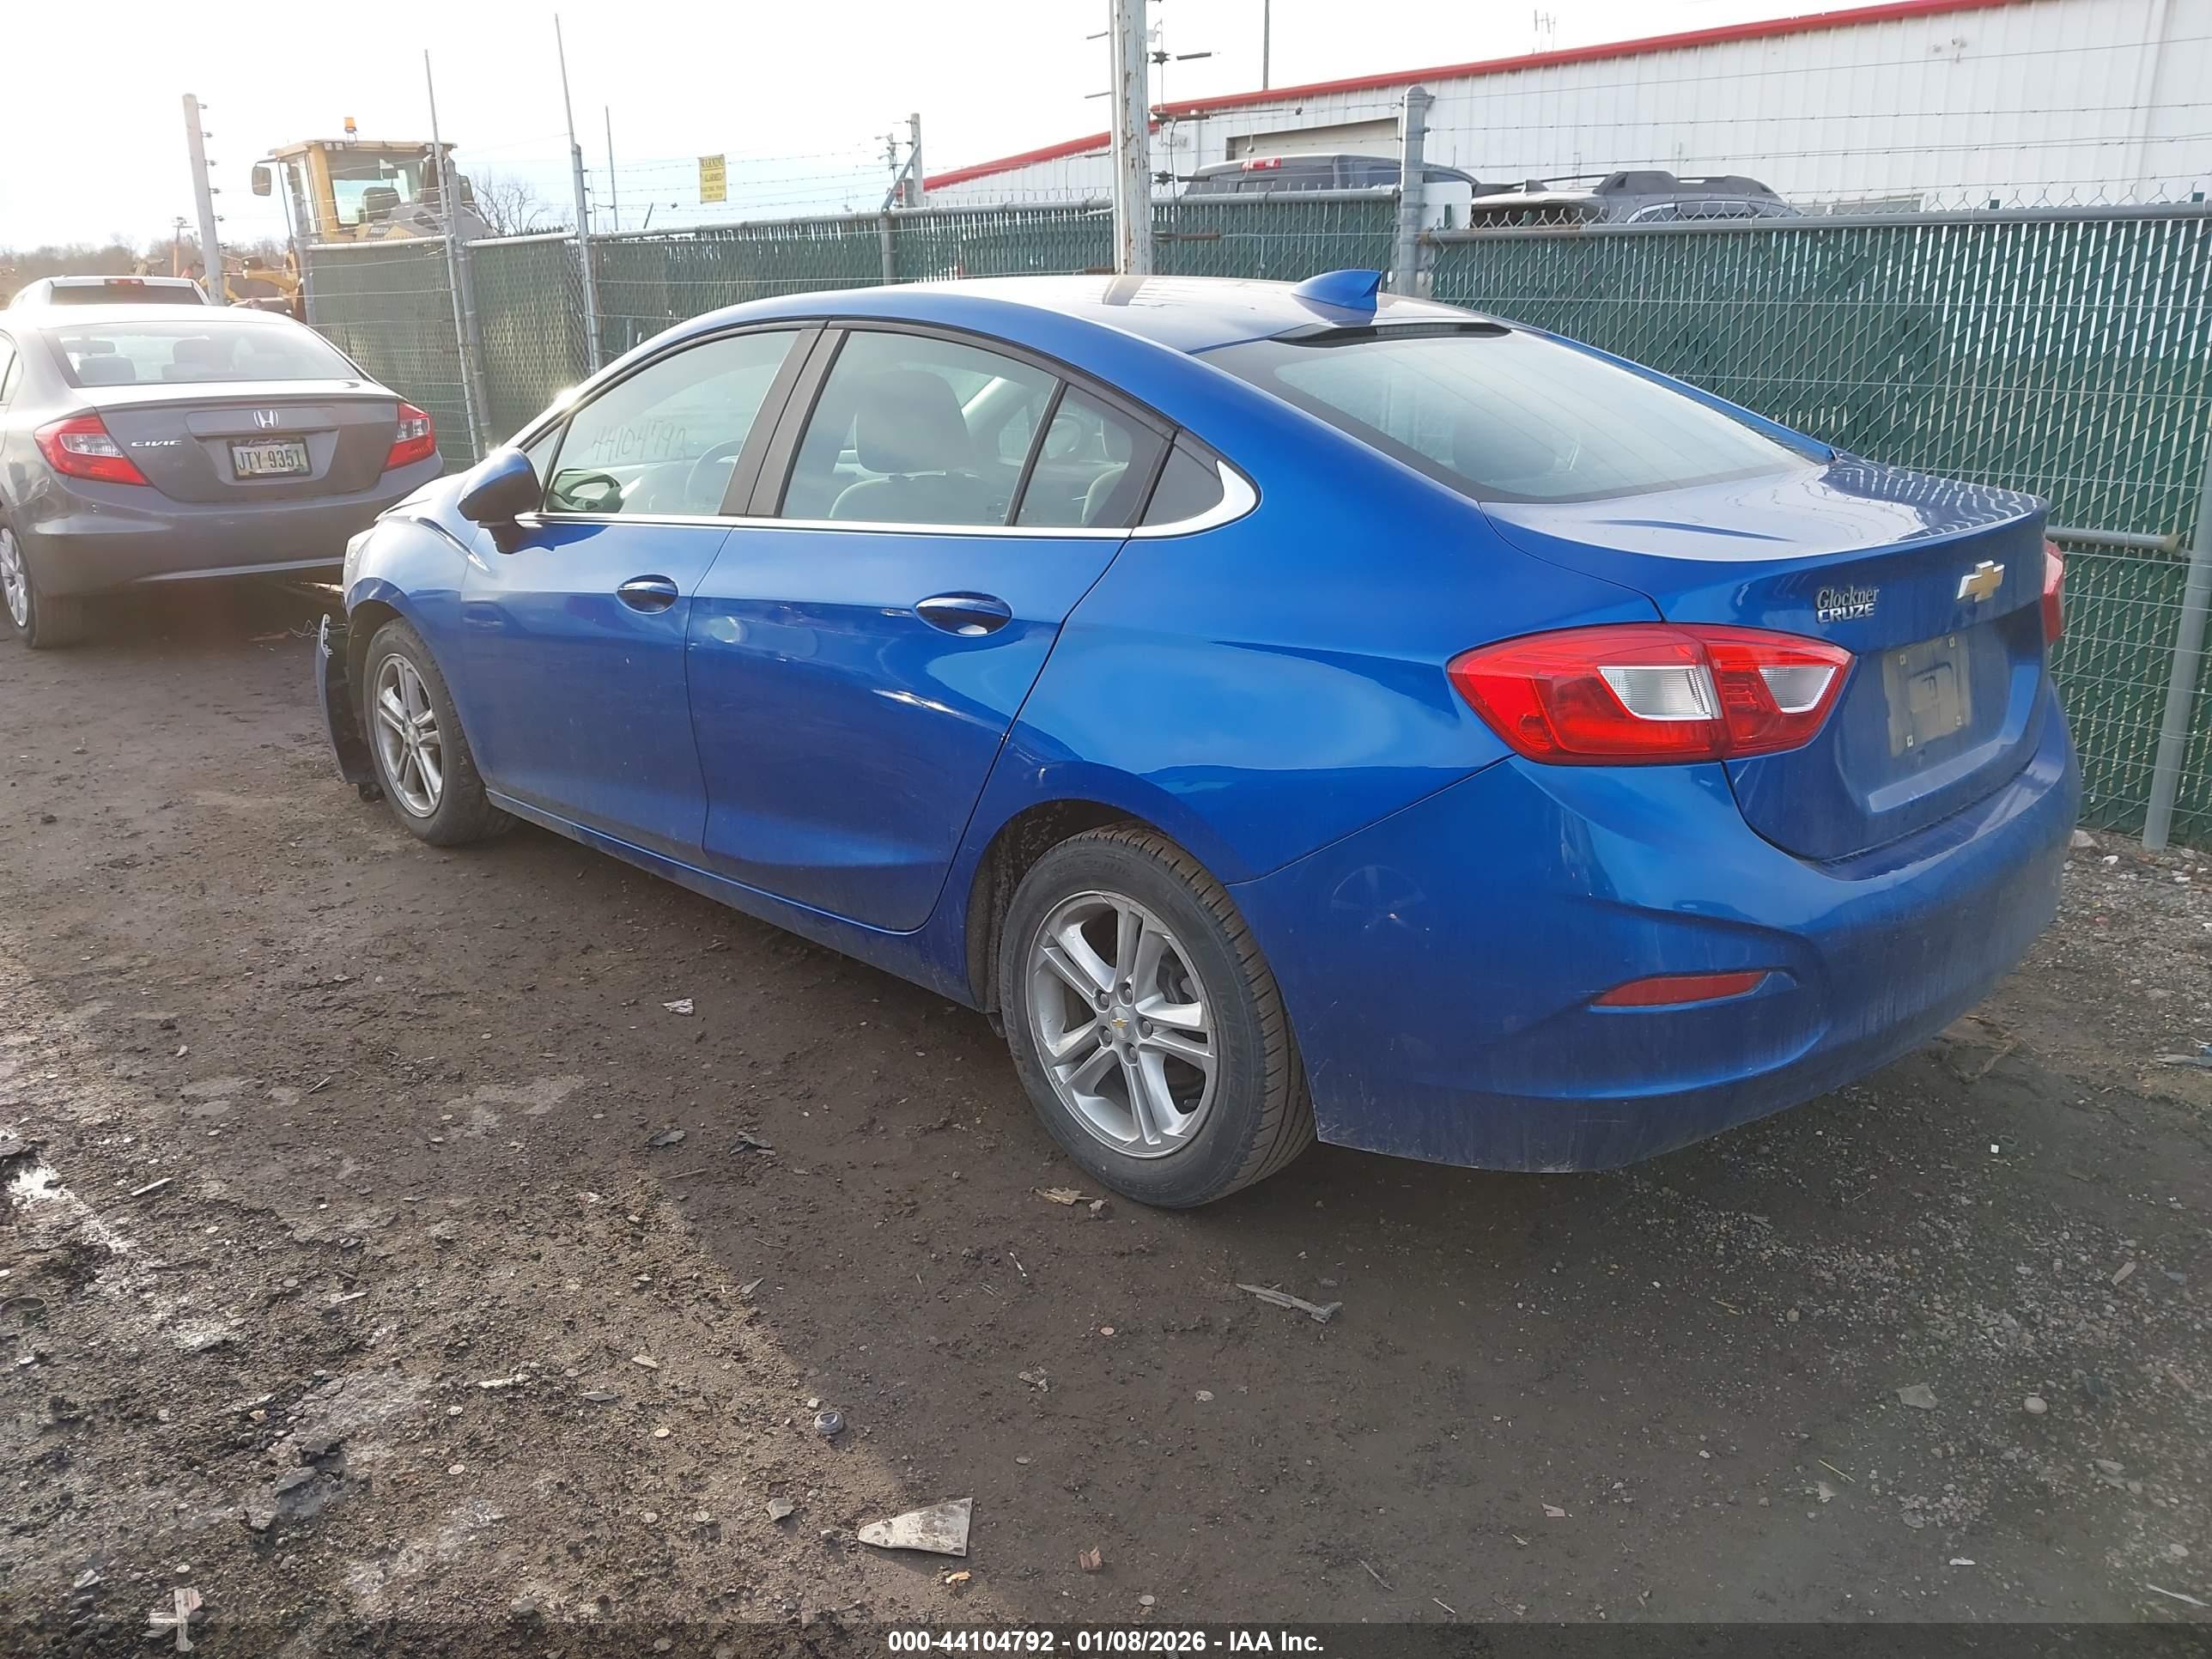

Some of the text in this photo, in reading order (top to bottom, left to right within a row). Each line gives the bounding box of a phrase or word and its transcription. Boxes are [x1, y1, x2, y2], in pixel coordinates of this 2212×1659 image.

[238, 449, 304, 471] JTY 9351
[1816, 585, 1880, 610] Glockner
[1817, 603, 1875, 623] CRUZE
